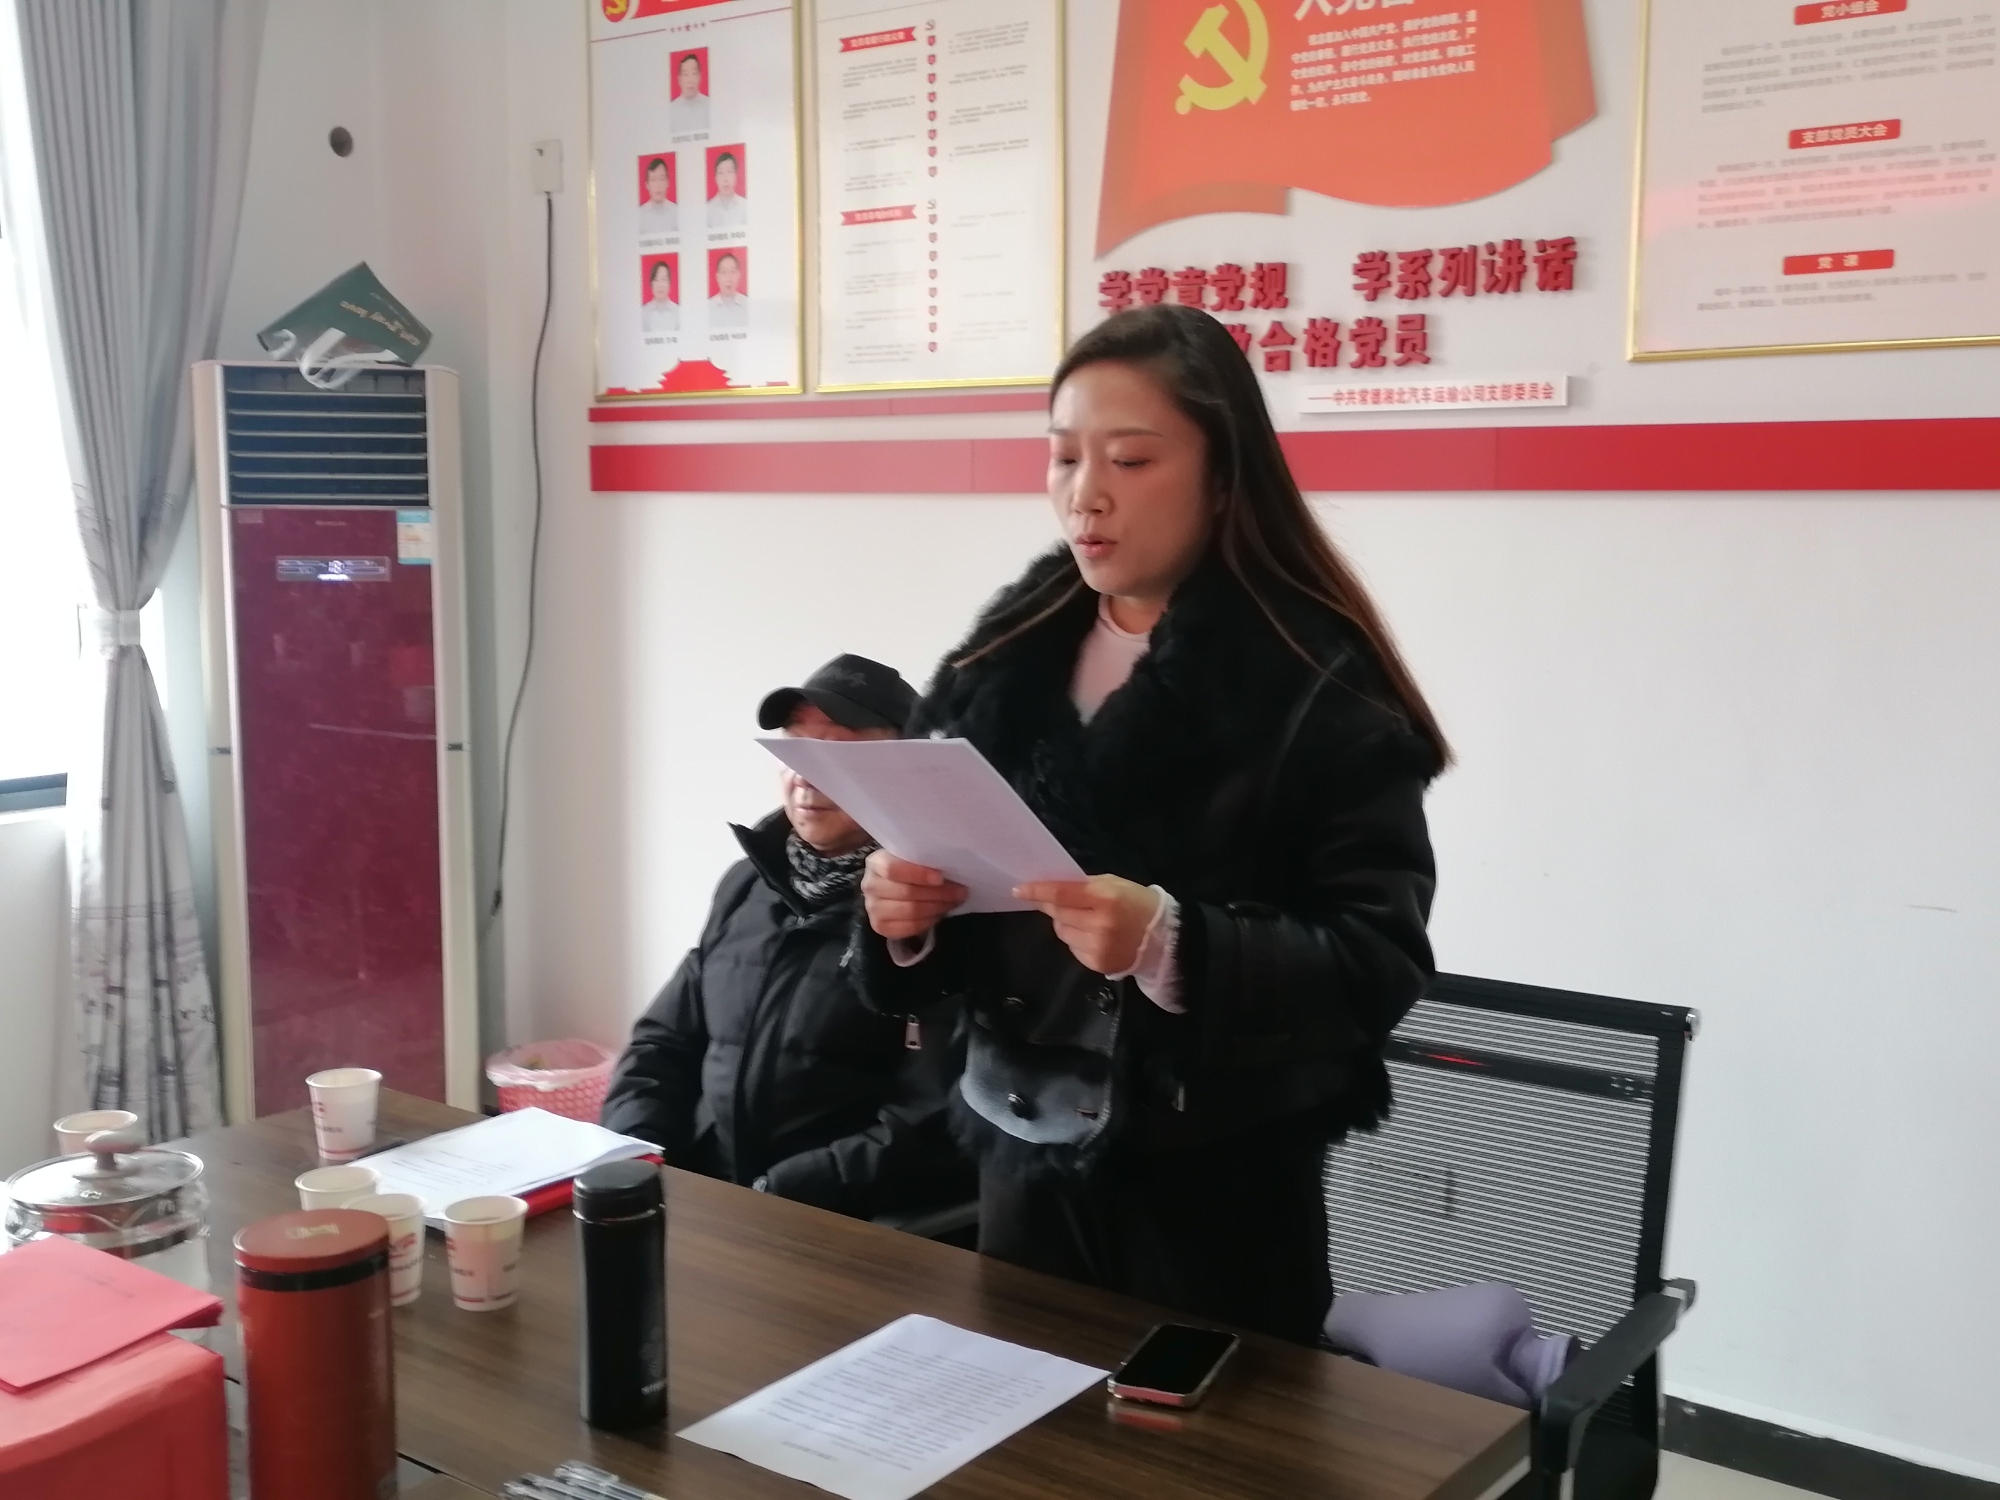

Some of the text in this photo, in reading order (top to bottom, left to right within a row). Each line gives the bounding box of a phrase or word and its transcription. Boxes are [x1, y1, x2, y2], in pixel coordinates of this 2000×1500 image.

[1800, 123, 1889, 144] 支部党员大会
[1099, 236, 1577, 313] 学党章党规 学系列讲话
